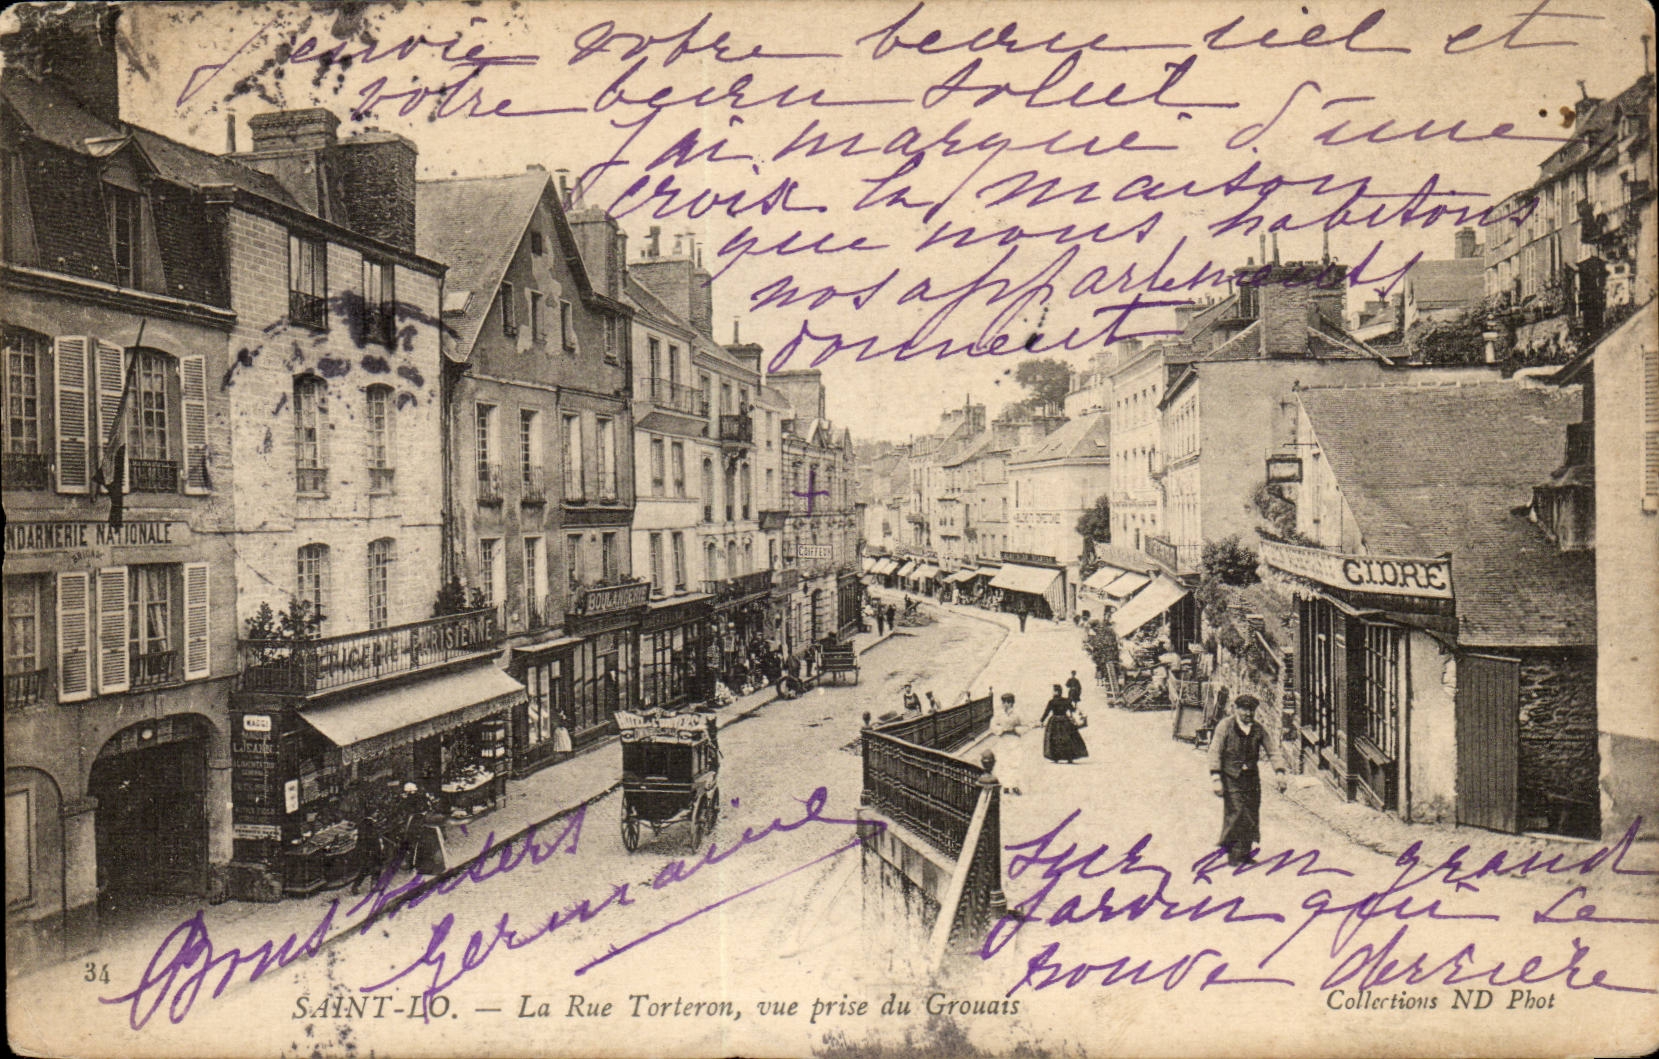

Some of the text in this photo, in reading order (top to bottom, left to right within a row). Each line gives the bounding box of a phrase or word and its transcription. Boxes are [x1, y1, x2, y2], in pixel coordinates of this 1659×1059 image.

[569, 13, 842, 66] votre
[1203, 7, 1411, 53] ciel
[1445, 0, 1606, 53] et
[351, 60, 588, 121] votre
[701, 174, 1540, 288] que nous habitons
[750, 268, 899, 312] nos
[96, 522, 172, 546] NATIONALE
[1343, 558, 1446, 590] CIDRE
[1385, 815, 1659, 892] grand
[99, 898, 340, 1030] Bons
